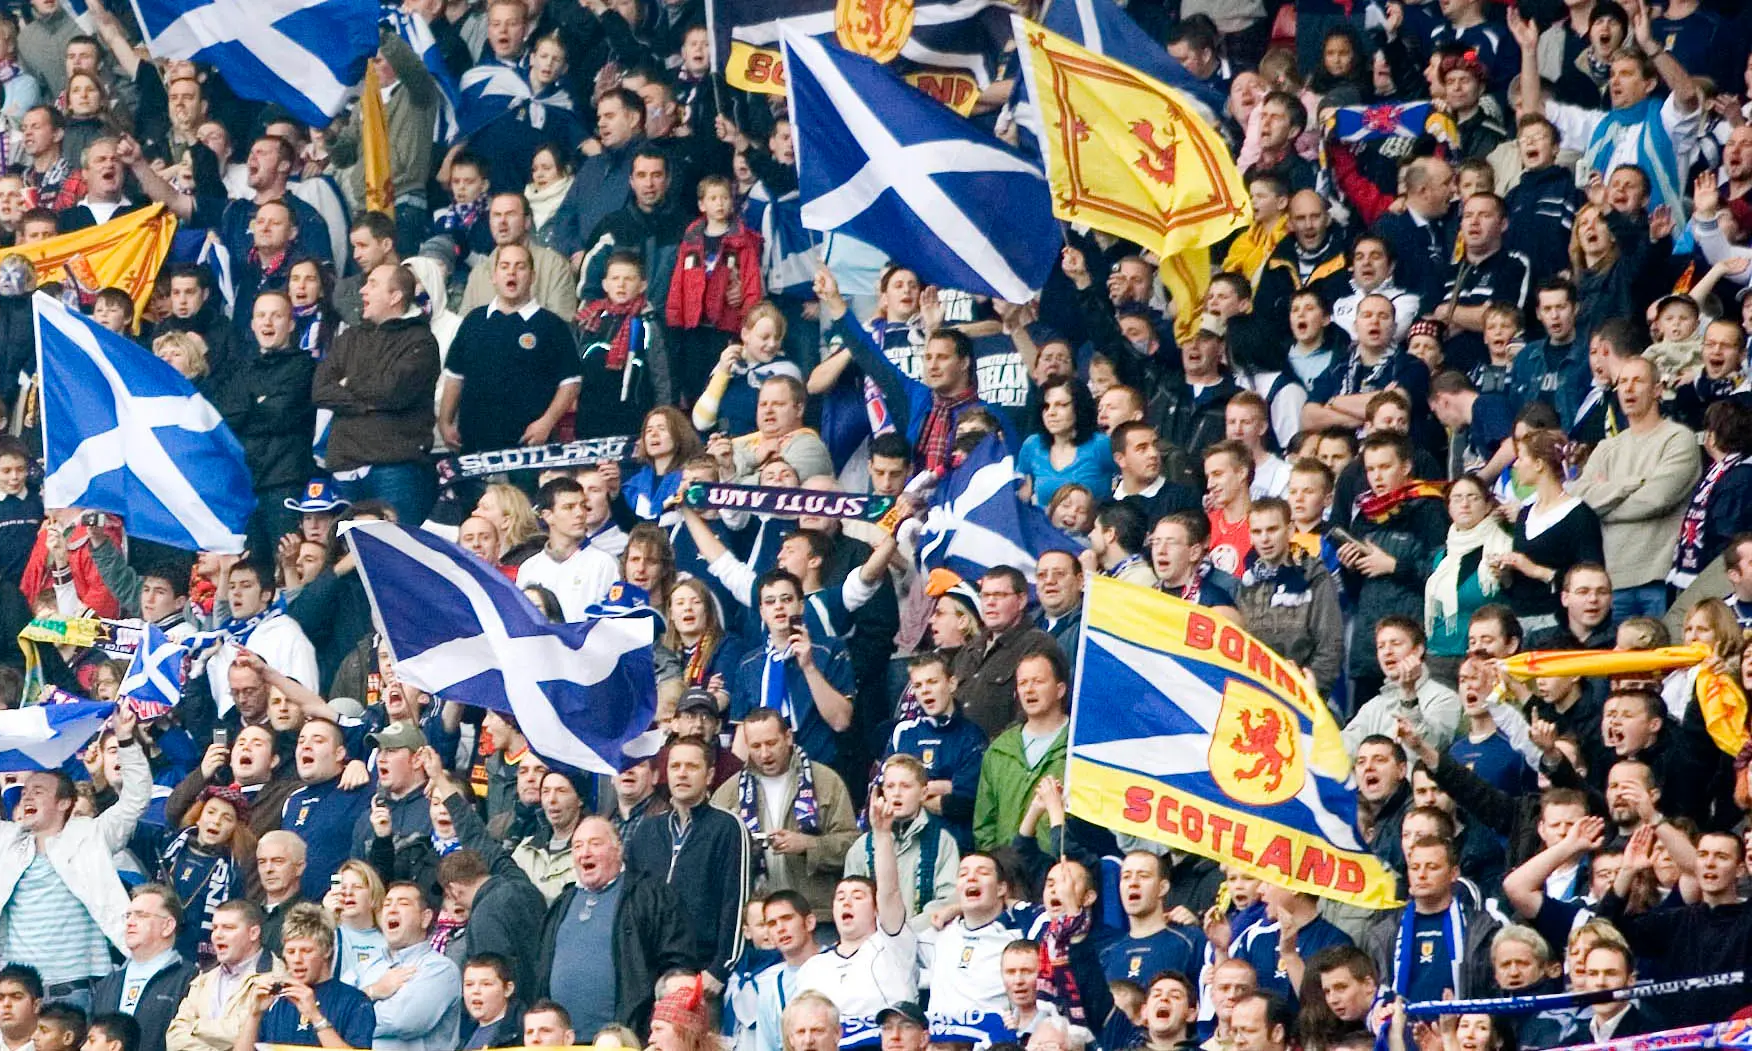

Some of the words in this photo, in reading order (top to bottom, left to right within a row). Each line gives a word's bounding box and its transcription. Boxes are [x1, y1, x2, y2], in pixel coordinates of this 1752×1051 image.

[458, 441, 627, 470] SCOTLAND
[1184, 611, 1316, 712] BONN
[1123, 785, 1366, 893] SCOTLAND
[845, 1009, 984, 1033] SCAND
